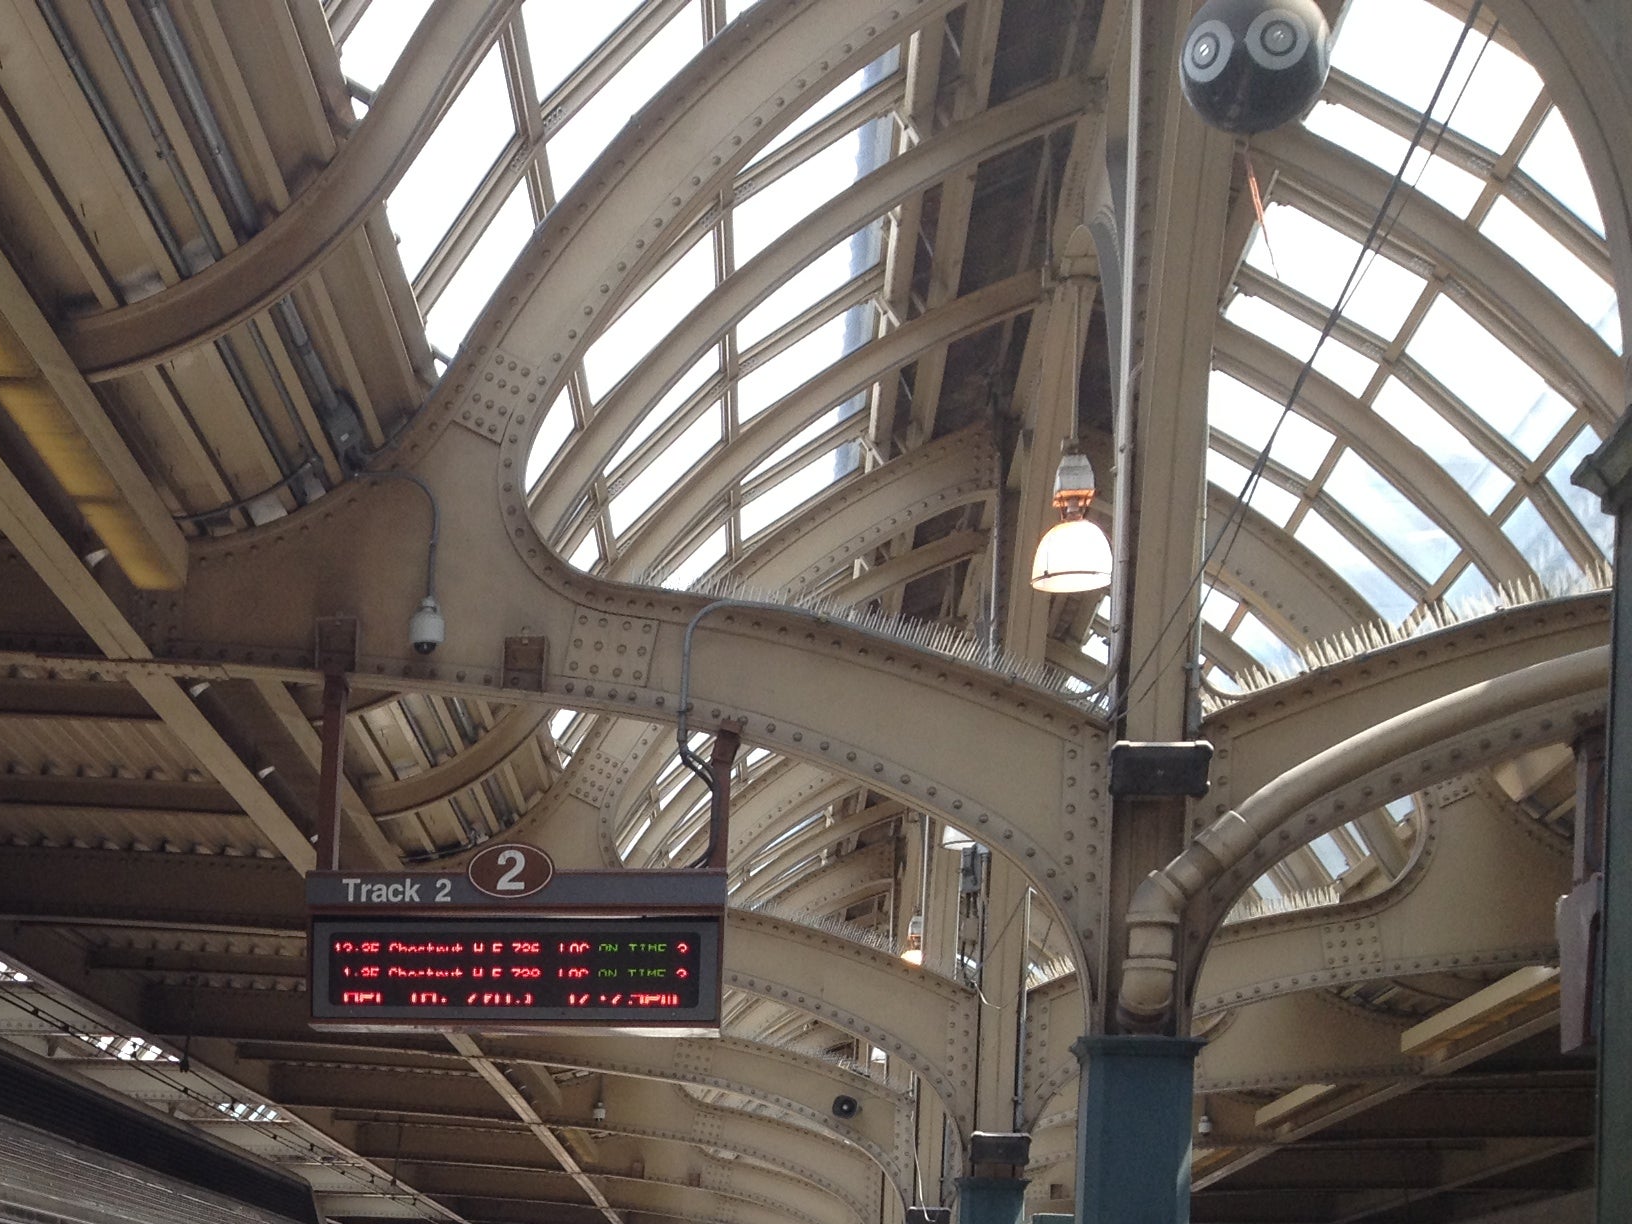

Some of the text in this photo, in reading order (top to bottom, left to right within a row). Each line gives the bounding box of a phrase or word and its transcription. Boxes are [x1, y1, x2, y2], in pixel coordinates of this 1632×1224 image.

[496, 849, 526, 891] 2
[342, 878, 452, 902] Track 2
[628, 943, 668, 952] TIME
[627, 968, 667, 977] TIME
